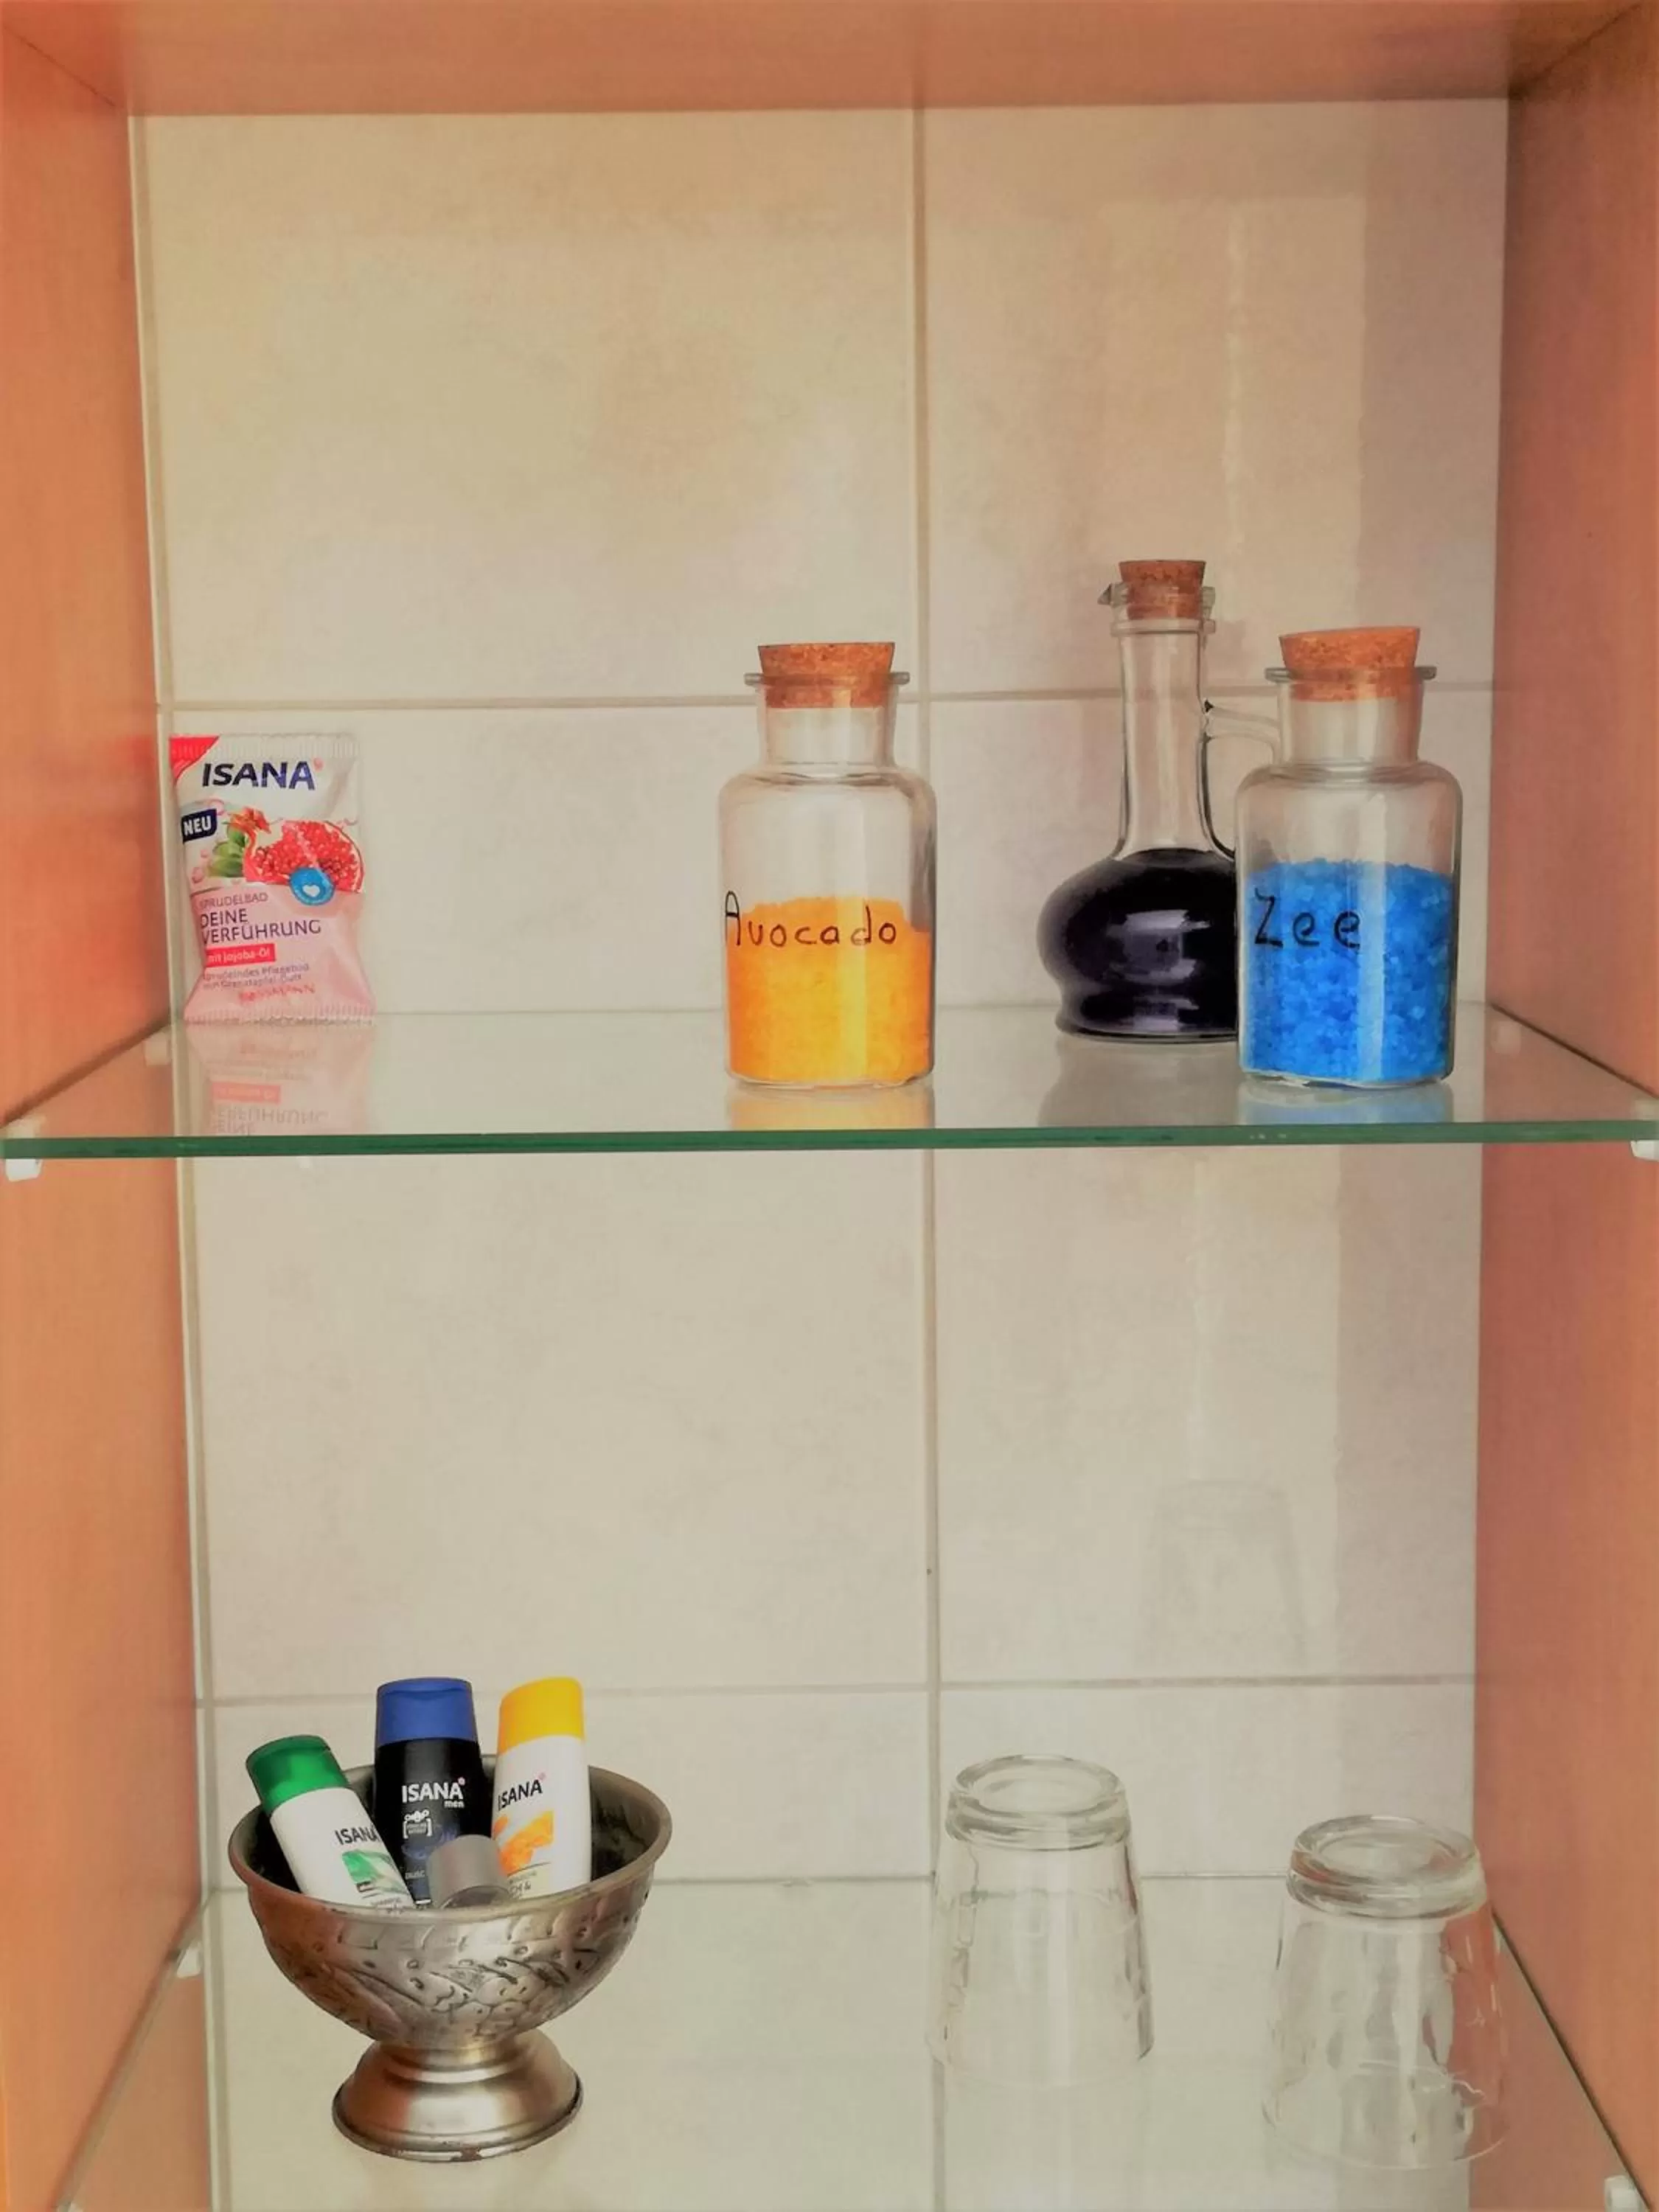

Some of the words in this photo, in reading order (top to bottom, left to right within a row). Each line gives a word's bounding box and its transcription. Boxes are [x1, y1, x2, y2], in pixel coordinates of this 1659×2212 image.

[202, 760, 316, 791] ISANA
[184, 815, 212, 837] NEU
[200, 908, 248, 930] DEINE
[725, 890, 897, 947] Avocado
[1254, 887, 1361, 949] Zee
[401, 1781, 465, 1804] ISANA
[444, 1799, 465, 1809] men
[497, 1778, 544, 1812] ISANA
